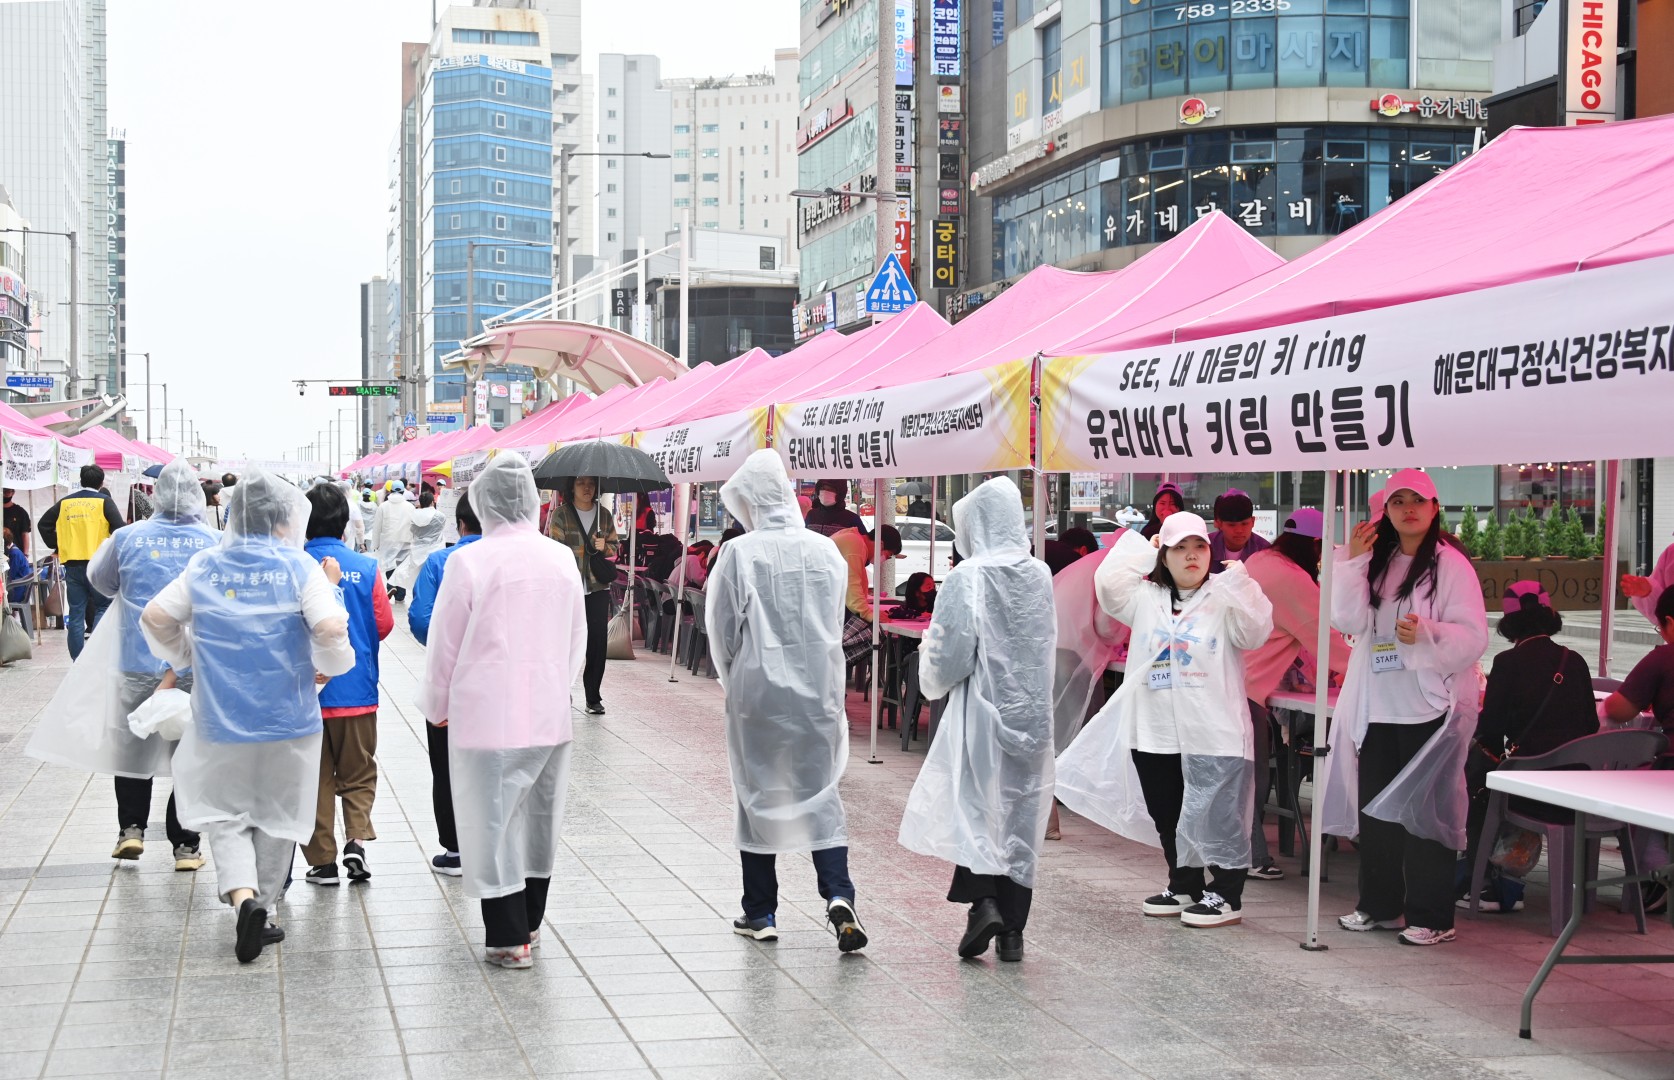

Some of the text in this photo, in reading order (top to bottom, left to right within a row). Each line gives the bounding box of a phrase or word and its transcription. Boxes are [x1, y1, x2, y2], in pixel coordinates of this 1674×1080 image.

[935, 8, 958, 20] 코인
[1175, 0, 1291, 21] 758-2335
[935, 22, 958, 34] 노래
[938, 63, 955, 73] 5F
[106, 144, 118, 253] HAEUNDAE
[935, 222, 956, 286] 궁타이
[616, 290, 625, 315] BAR
[1119, 330, 1366, 392] SEE, 내 마음의 키 ring
[801, 397, 885, 428] SEE, 내 마음의 키 ring
[900, 402, 984, 438] 해운대구정신건강복지센터
[1086, 379, 1415, 460] 유리바다 키링 만들기
[788, 428, 898, 470] 유리바다 키링 만들기
[134, 536, 205, 548] 온누리 봉사단
[209, 572, 289, 586] 온누리 봉사단
[1475, 567, 1618, 604] ad Dog
[1375, 654, 1399, 664] STAFF
